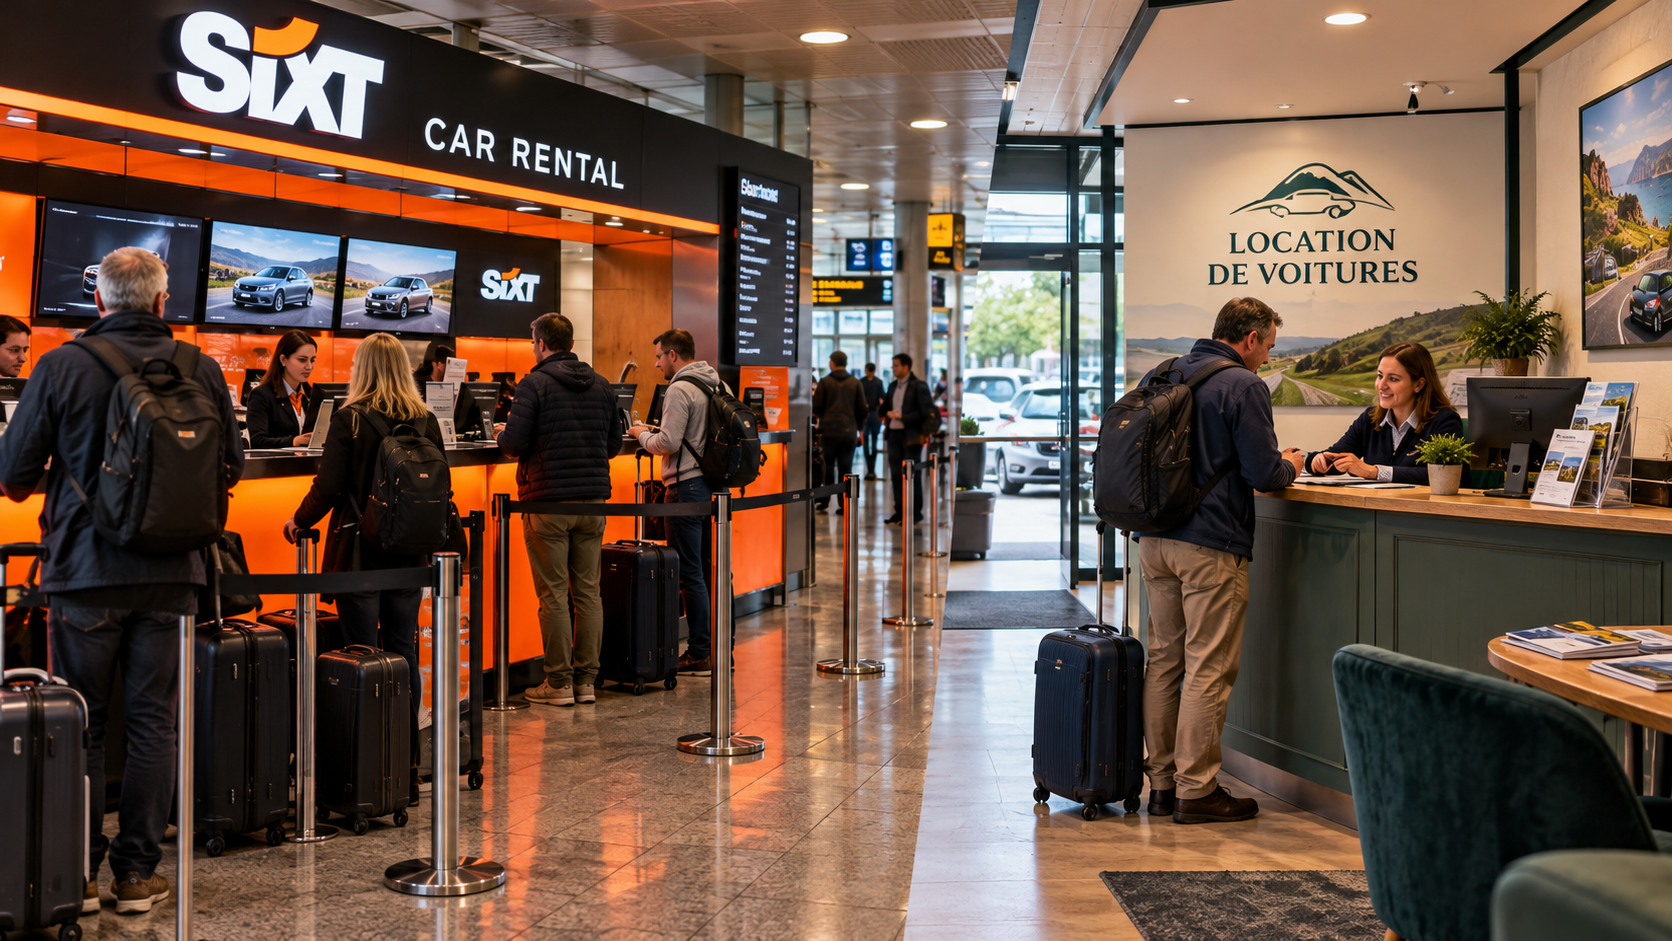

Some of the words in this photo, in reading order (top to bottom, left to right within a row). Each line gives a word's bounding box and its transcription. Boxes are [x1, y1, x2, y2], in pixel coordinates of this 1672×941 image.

[424, 118, 496, 162] CAR
[512, 137, 624, 189] RENTAL
[1229, 228, 1396, 254] LOCATION
[1208, 263, 1249, 286] DE
[1257, 260, 1418, 285] VOITURES
